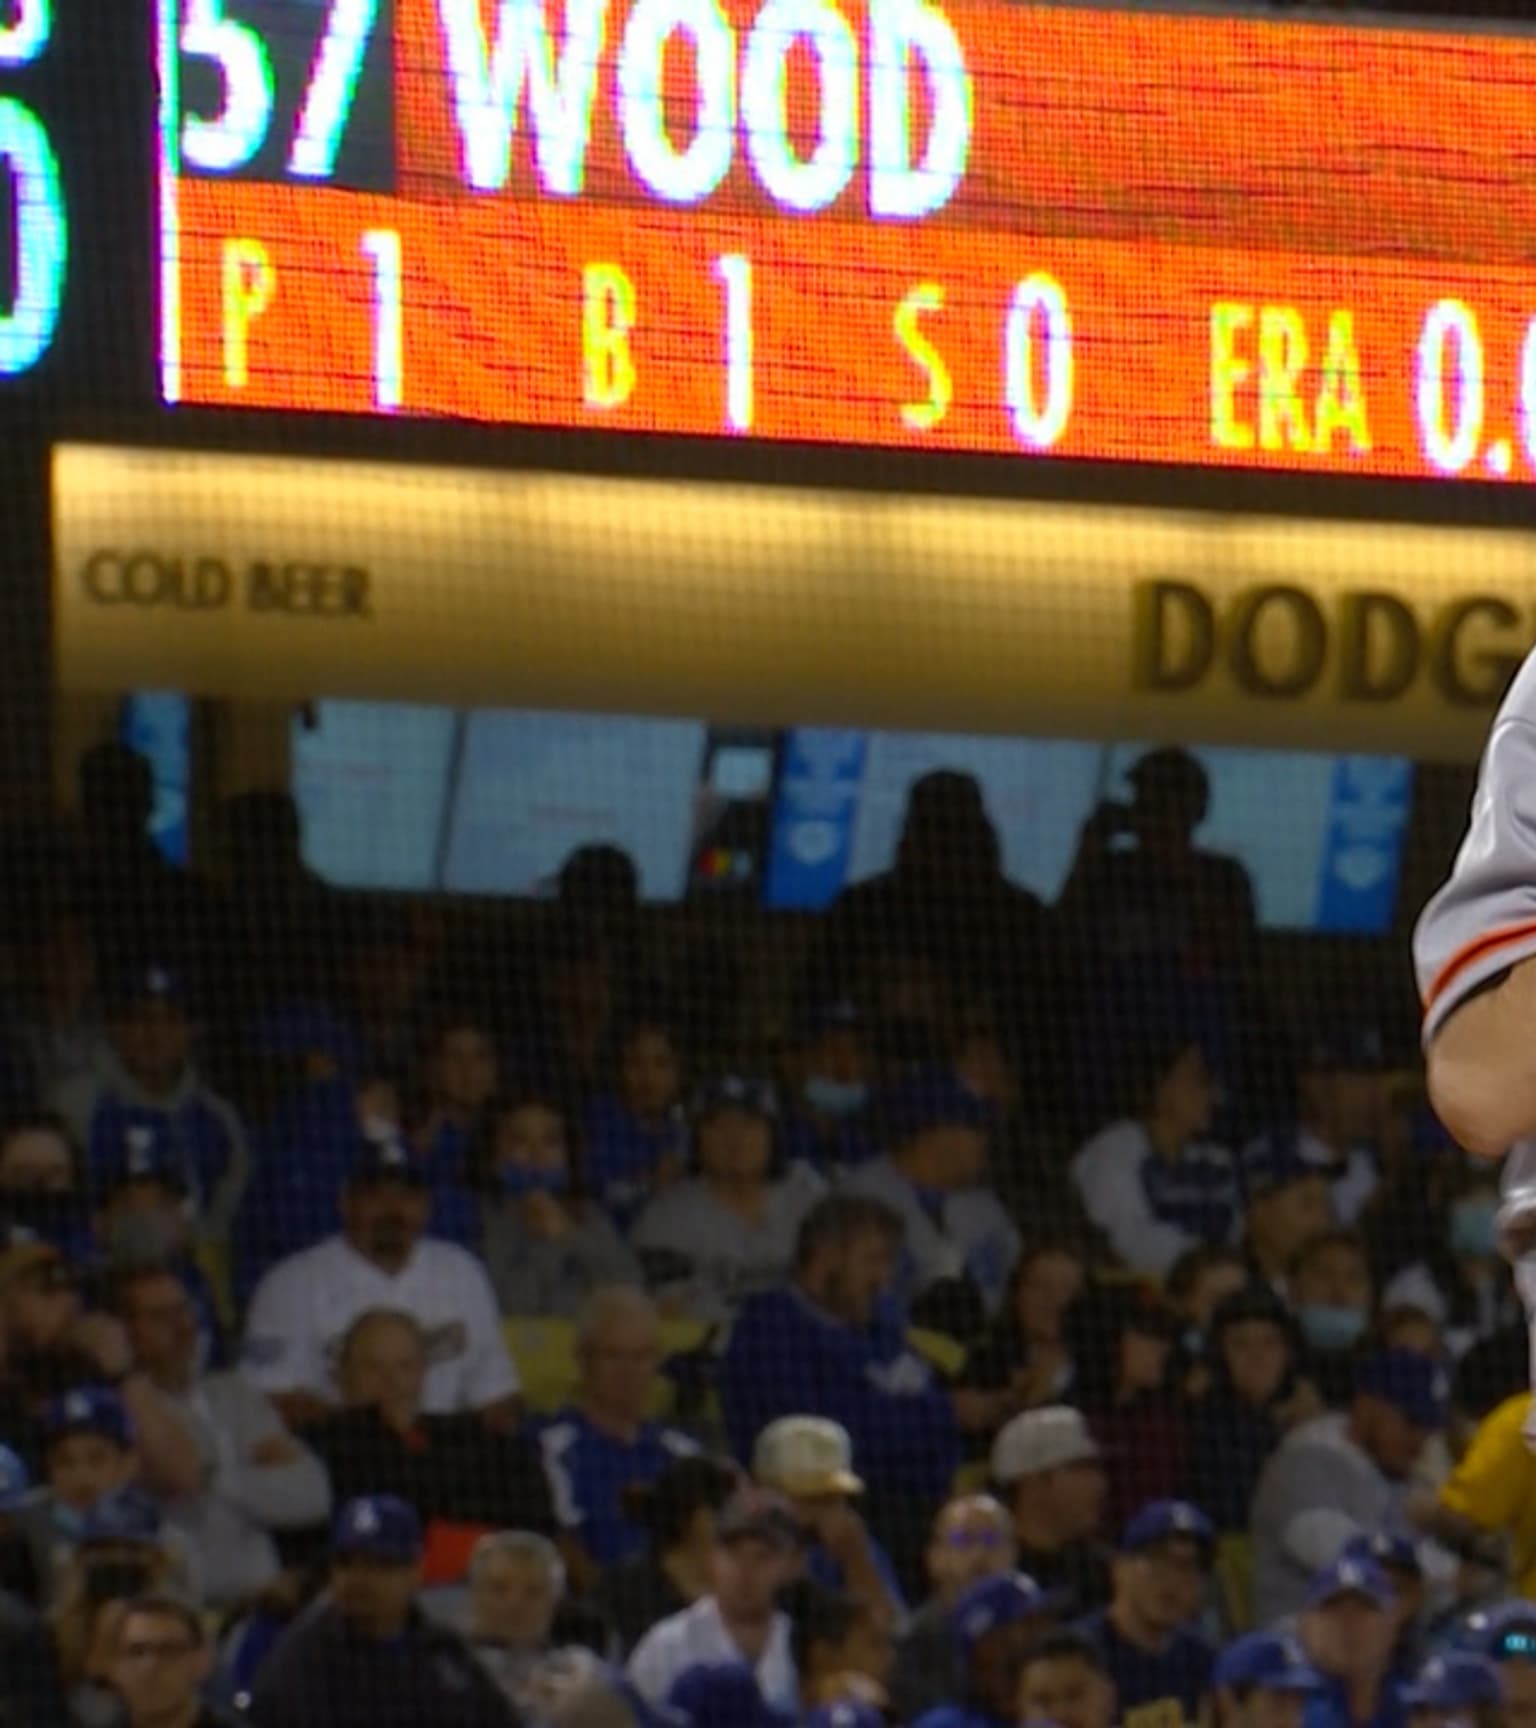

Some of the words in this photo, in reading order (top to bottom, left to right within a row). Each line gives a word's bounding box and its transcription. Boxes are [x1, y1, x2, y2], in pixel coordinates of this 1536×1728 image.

[440, 0, 973, 219] WOOD
[222, 239, 272, 387] P
[362, 229, 403, 408] 1
[582, 262, 637, 407] B
[712, 254, 753, 432] 1
[893, 284, 952, 429] S
[1005, 273, 1072, 446] 0
[1210, 302, 1370, 454] ERA
[82, 549, 232, 611] COLD
[248, 561, 373, 620] BEER
